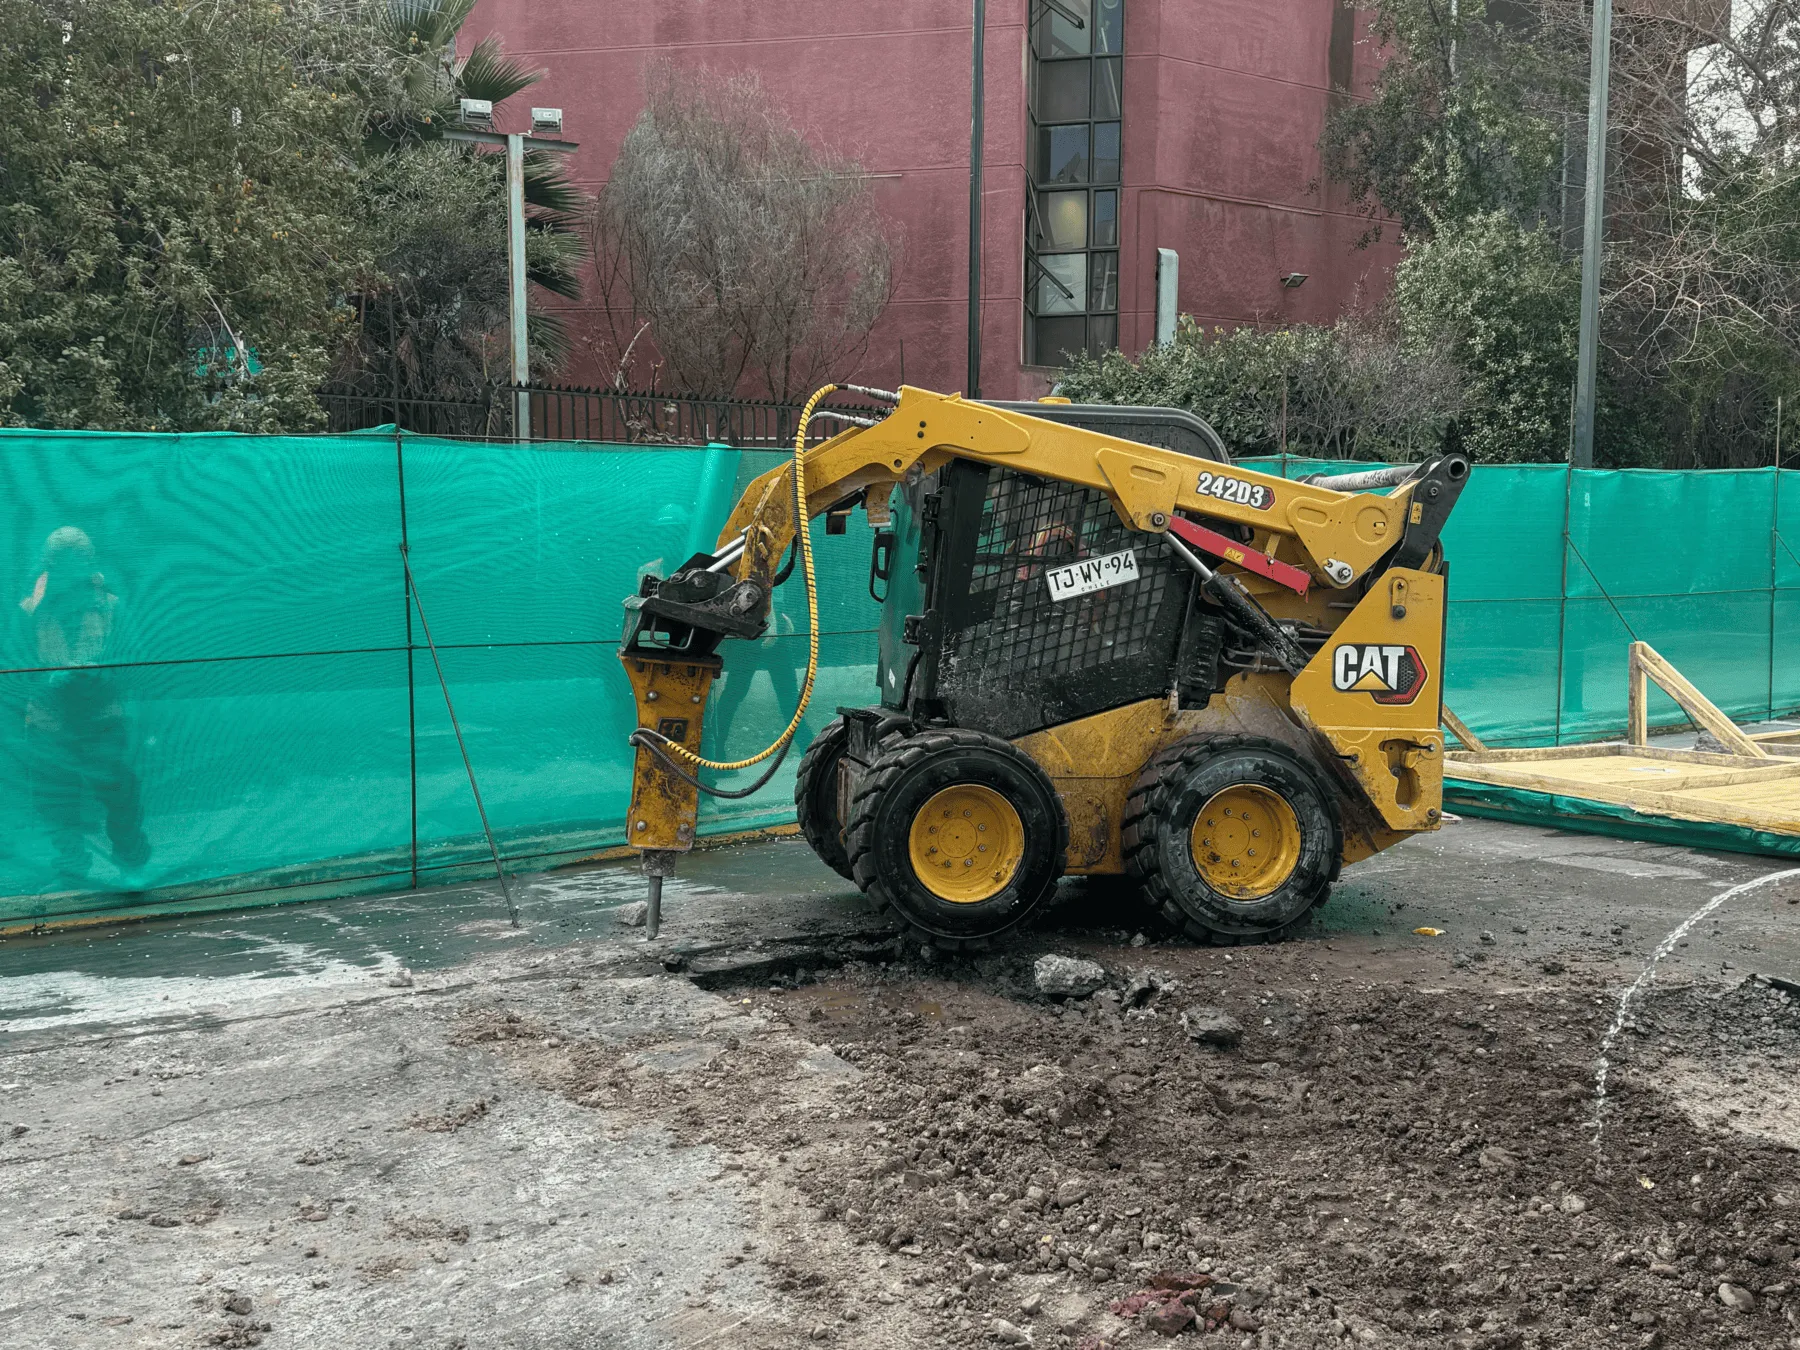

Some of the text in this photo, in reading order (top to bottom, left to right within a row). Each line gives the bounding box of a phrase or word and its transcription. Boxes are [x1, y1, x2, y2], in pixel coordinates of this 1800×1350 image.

[1197, 472, 1265, 507] 242D3
[1081, 580, 1110, 592] CHILE
[1335, 645, 1404, 690] CAT
